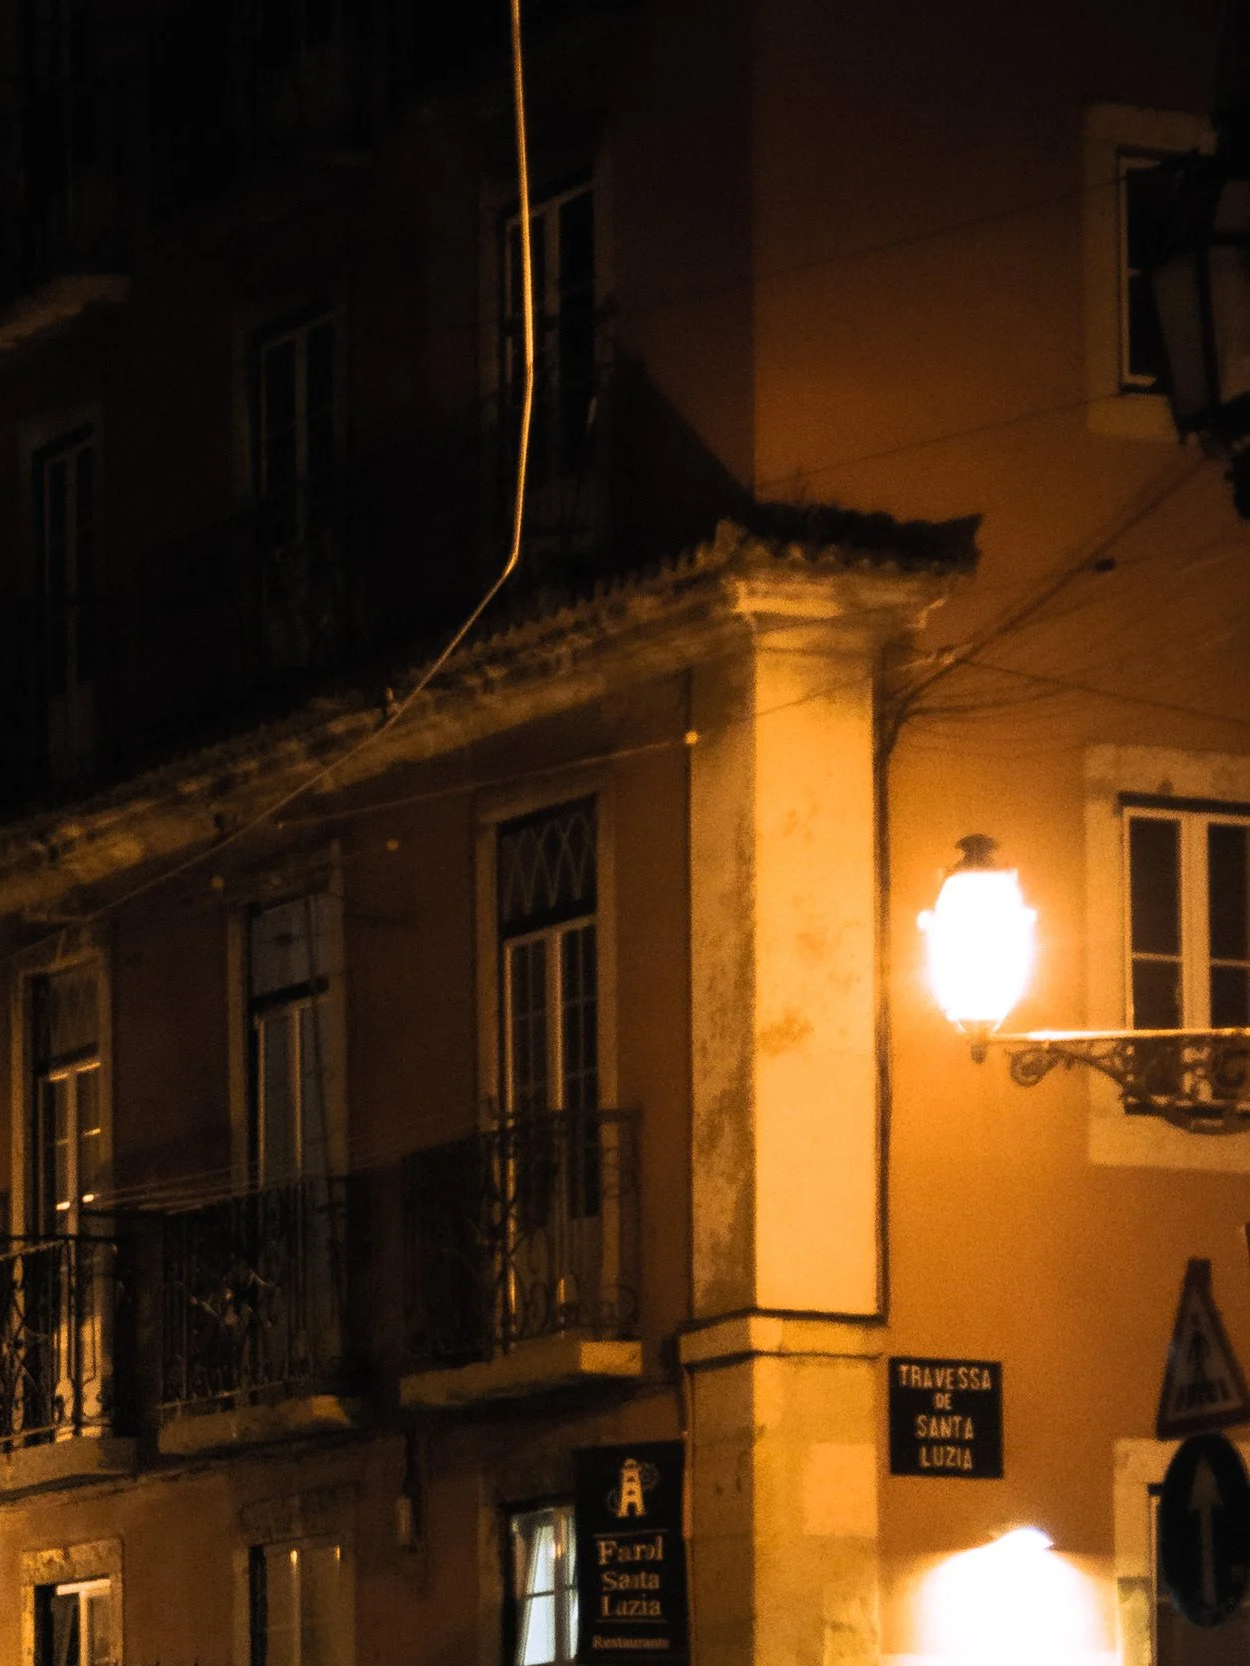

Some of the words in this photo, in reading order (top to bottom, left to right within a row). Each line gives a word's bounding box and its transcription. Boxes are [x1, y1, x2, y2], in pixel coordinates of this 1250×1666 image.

[899, 1363, 992, 1391] TRAVESSA
[932, 1391, 953, 1411] DE
[915, 1414, 974, 1441] SANTA
[919, 1444, 973, 1471] LUZIA
[596, 1535, 665, 1567] Farol
[600, 1570, 661, 1592] Santa
[600, 1594, 663, 1617] Luzia
